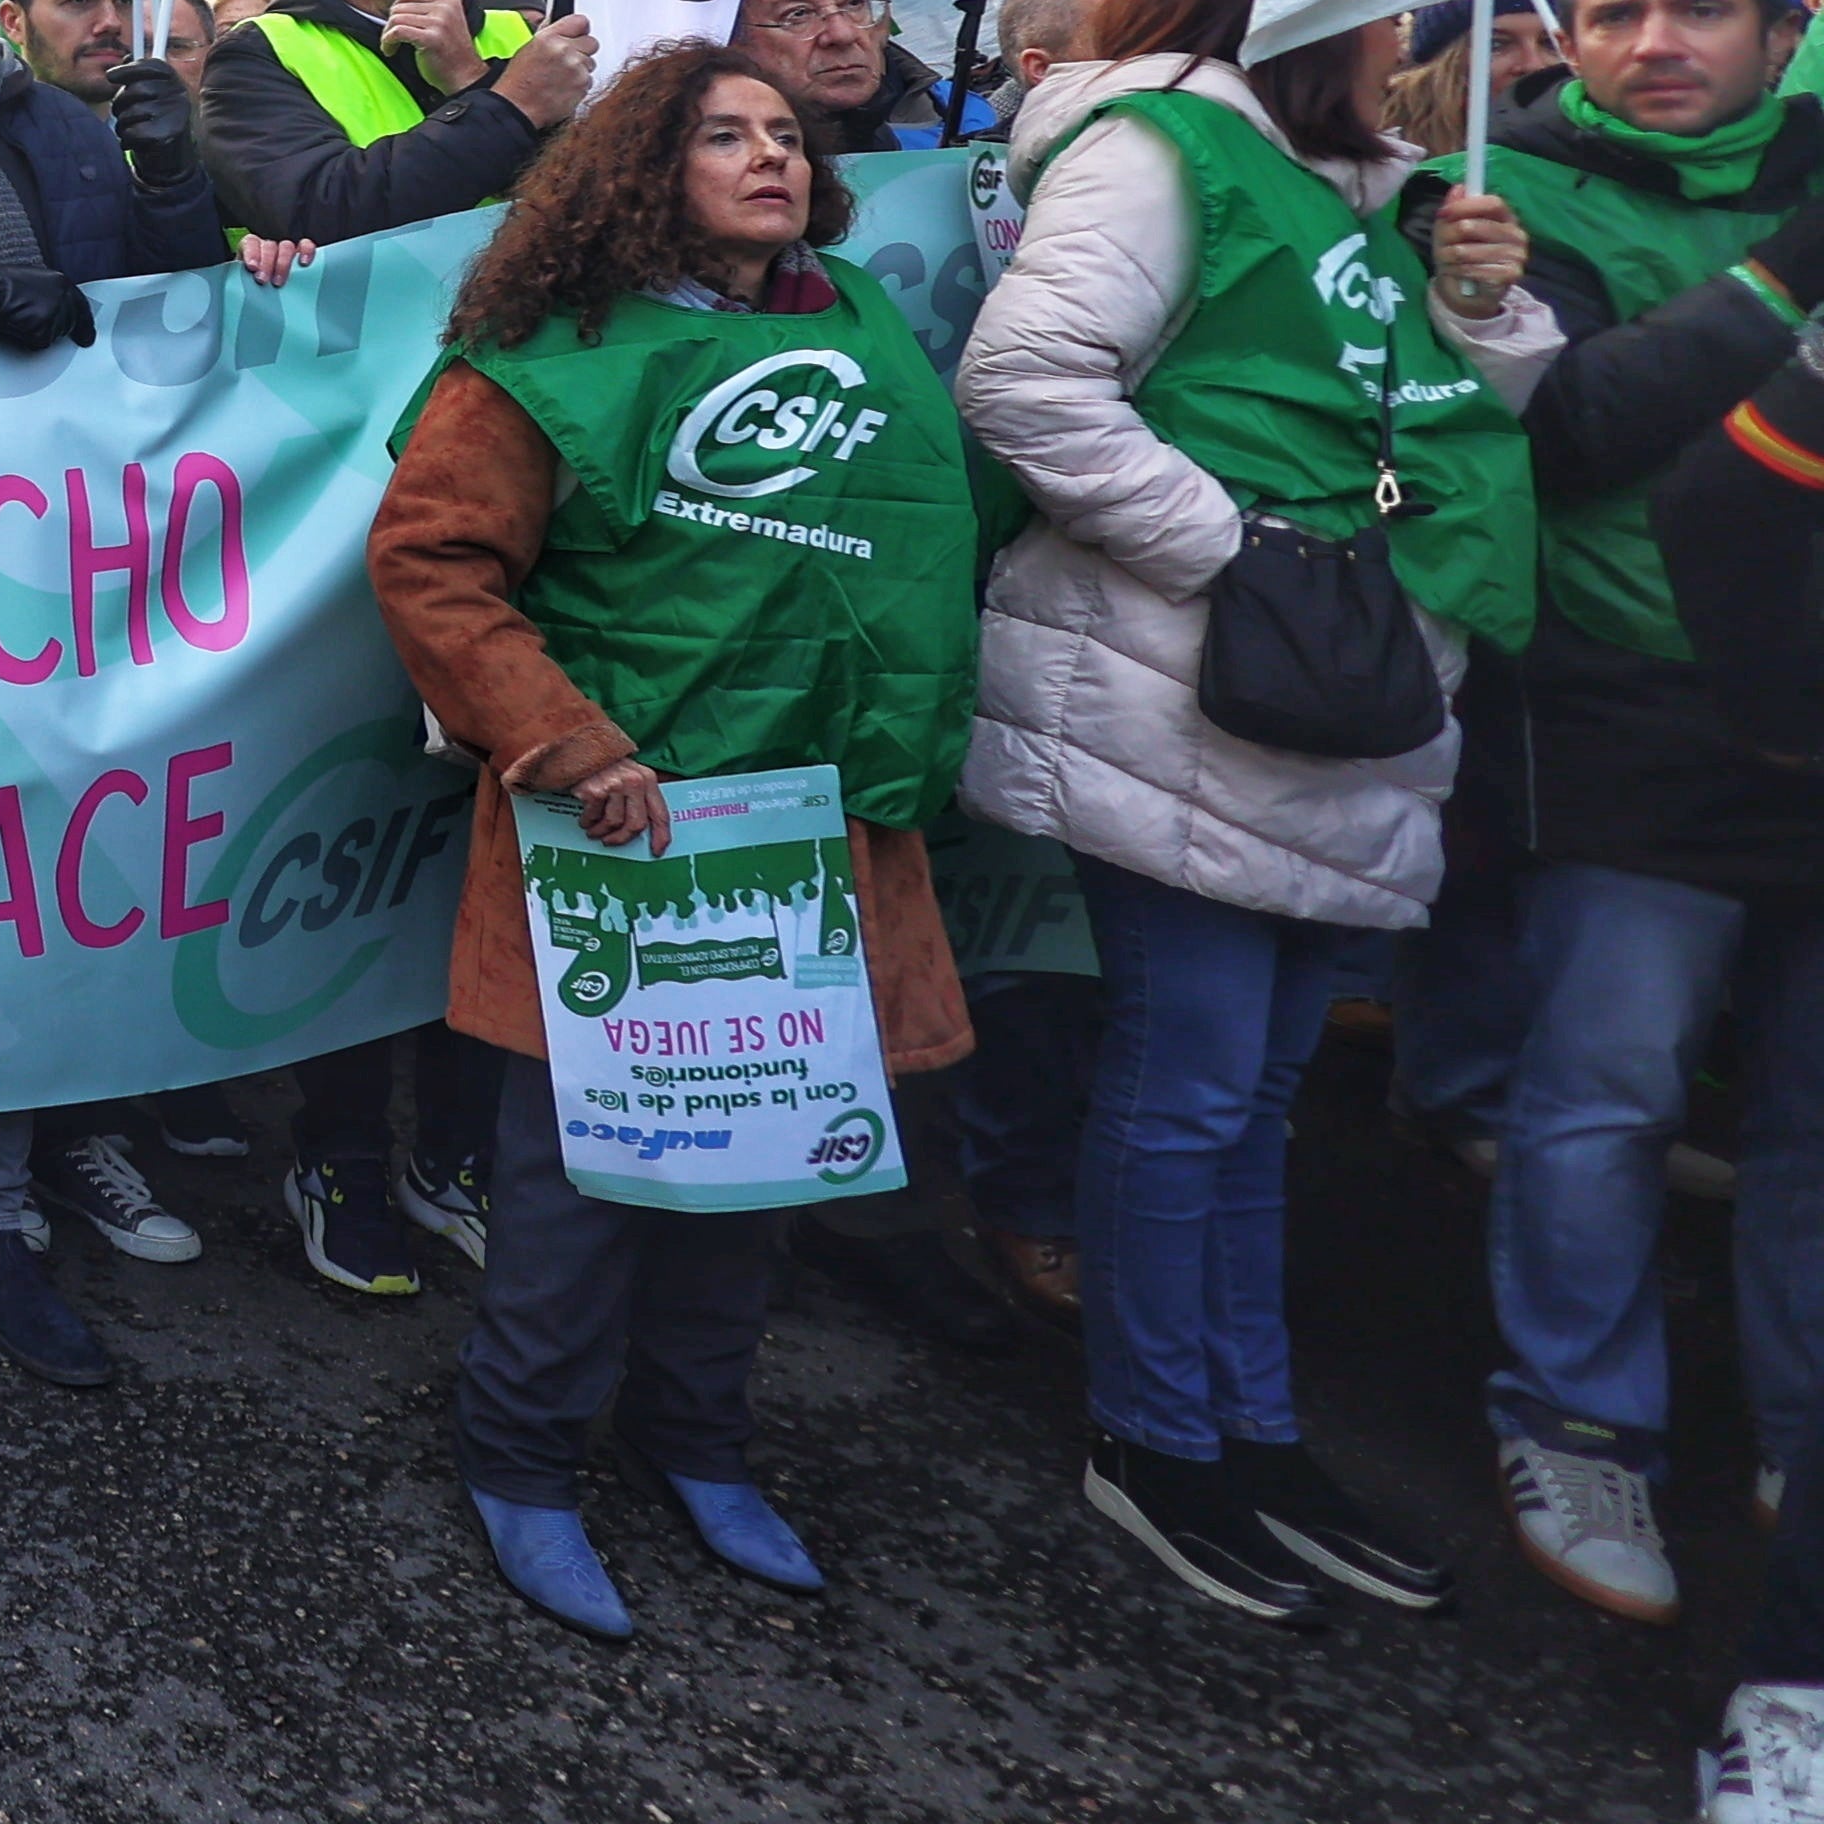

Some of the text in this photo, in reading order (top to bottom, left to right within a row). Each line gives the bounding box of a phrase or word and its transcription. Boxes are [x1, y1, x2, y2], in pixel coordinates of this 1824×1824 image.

[651, 490, 873, 560] Extremadura
[602, 1007, 826, 1057] NO SE JUEGA
[629, 1057, 809, 1088] funcionari@s
[583, 1081, 858, 1117] Con la salud de l@s
[804, 1132, 871, 1166] CSIF
